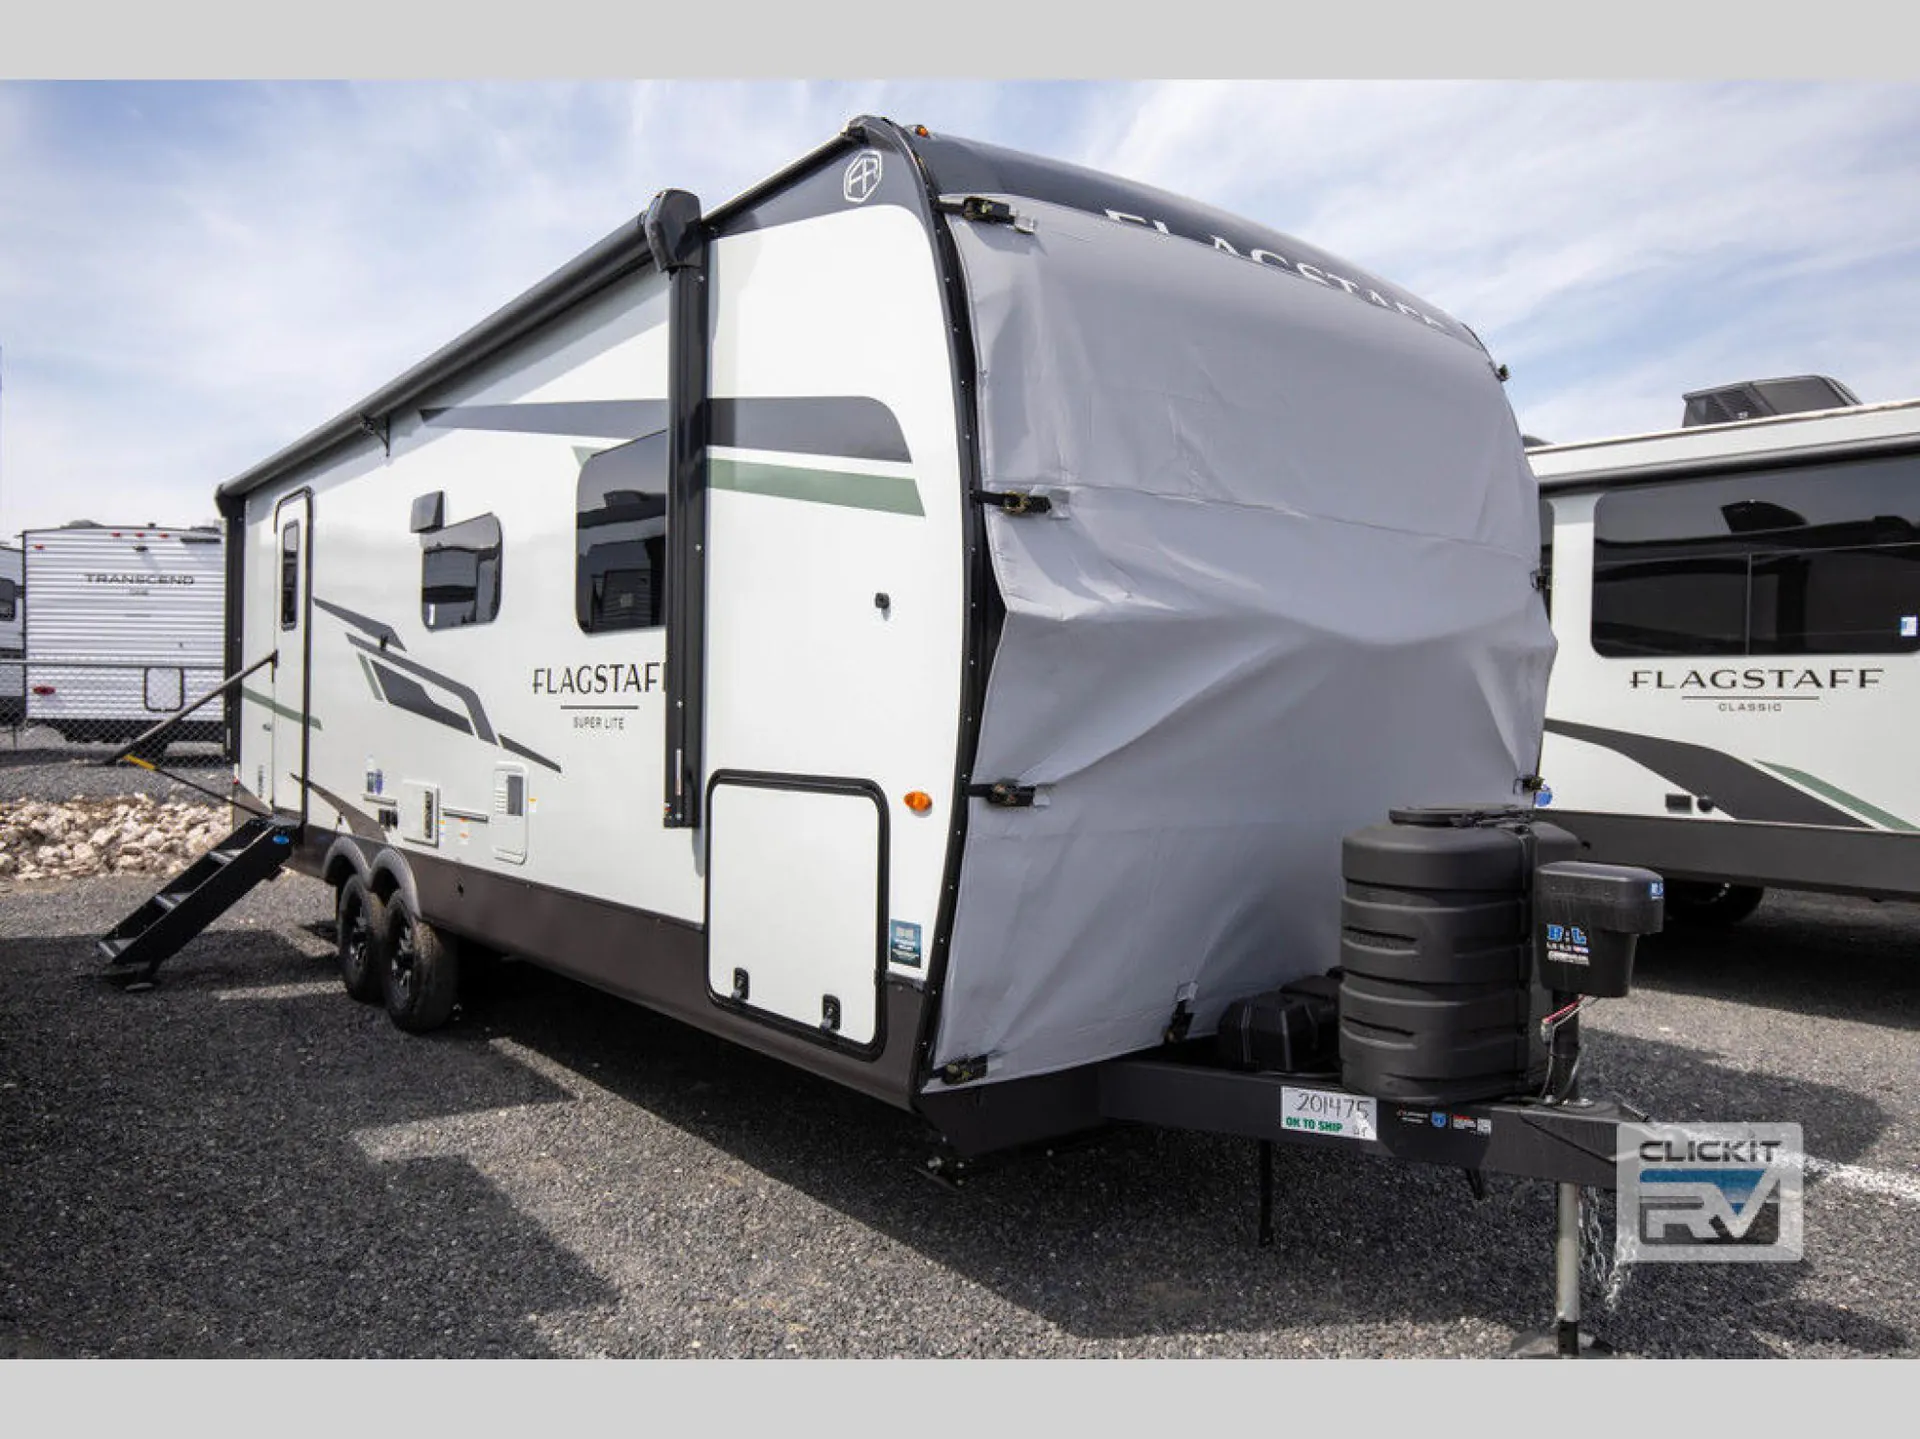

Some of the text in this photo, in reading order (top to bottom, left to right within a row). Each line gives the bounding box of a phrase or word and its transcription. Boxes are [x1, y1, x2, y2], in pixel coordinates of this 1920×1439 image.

[85, 573, 195, 585] TRANSCEND
[1629, 668, 1885, 690] FLAGSTAFF
[1718, 702, 1782, 713] CLASSIC
[573, 715, 625, 731] SUPER LITE
[1292, 1093, 1370, 1120] 201475
[1302, 1118, 1316, 1130] TO
[1317, 1120, 1344, 1133] SHIP
